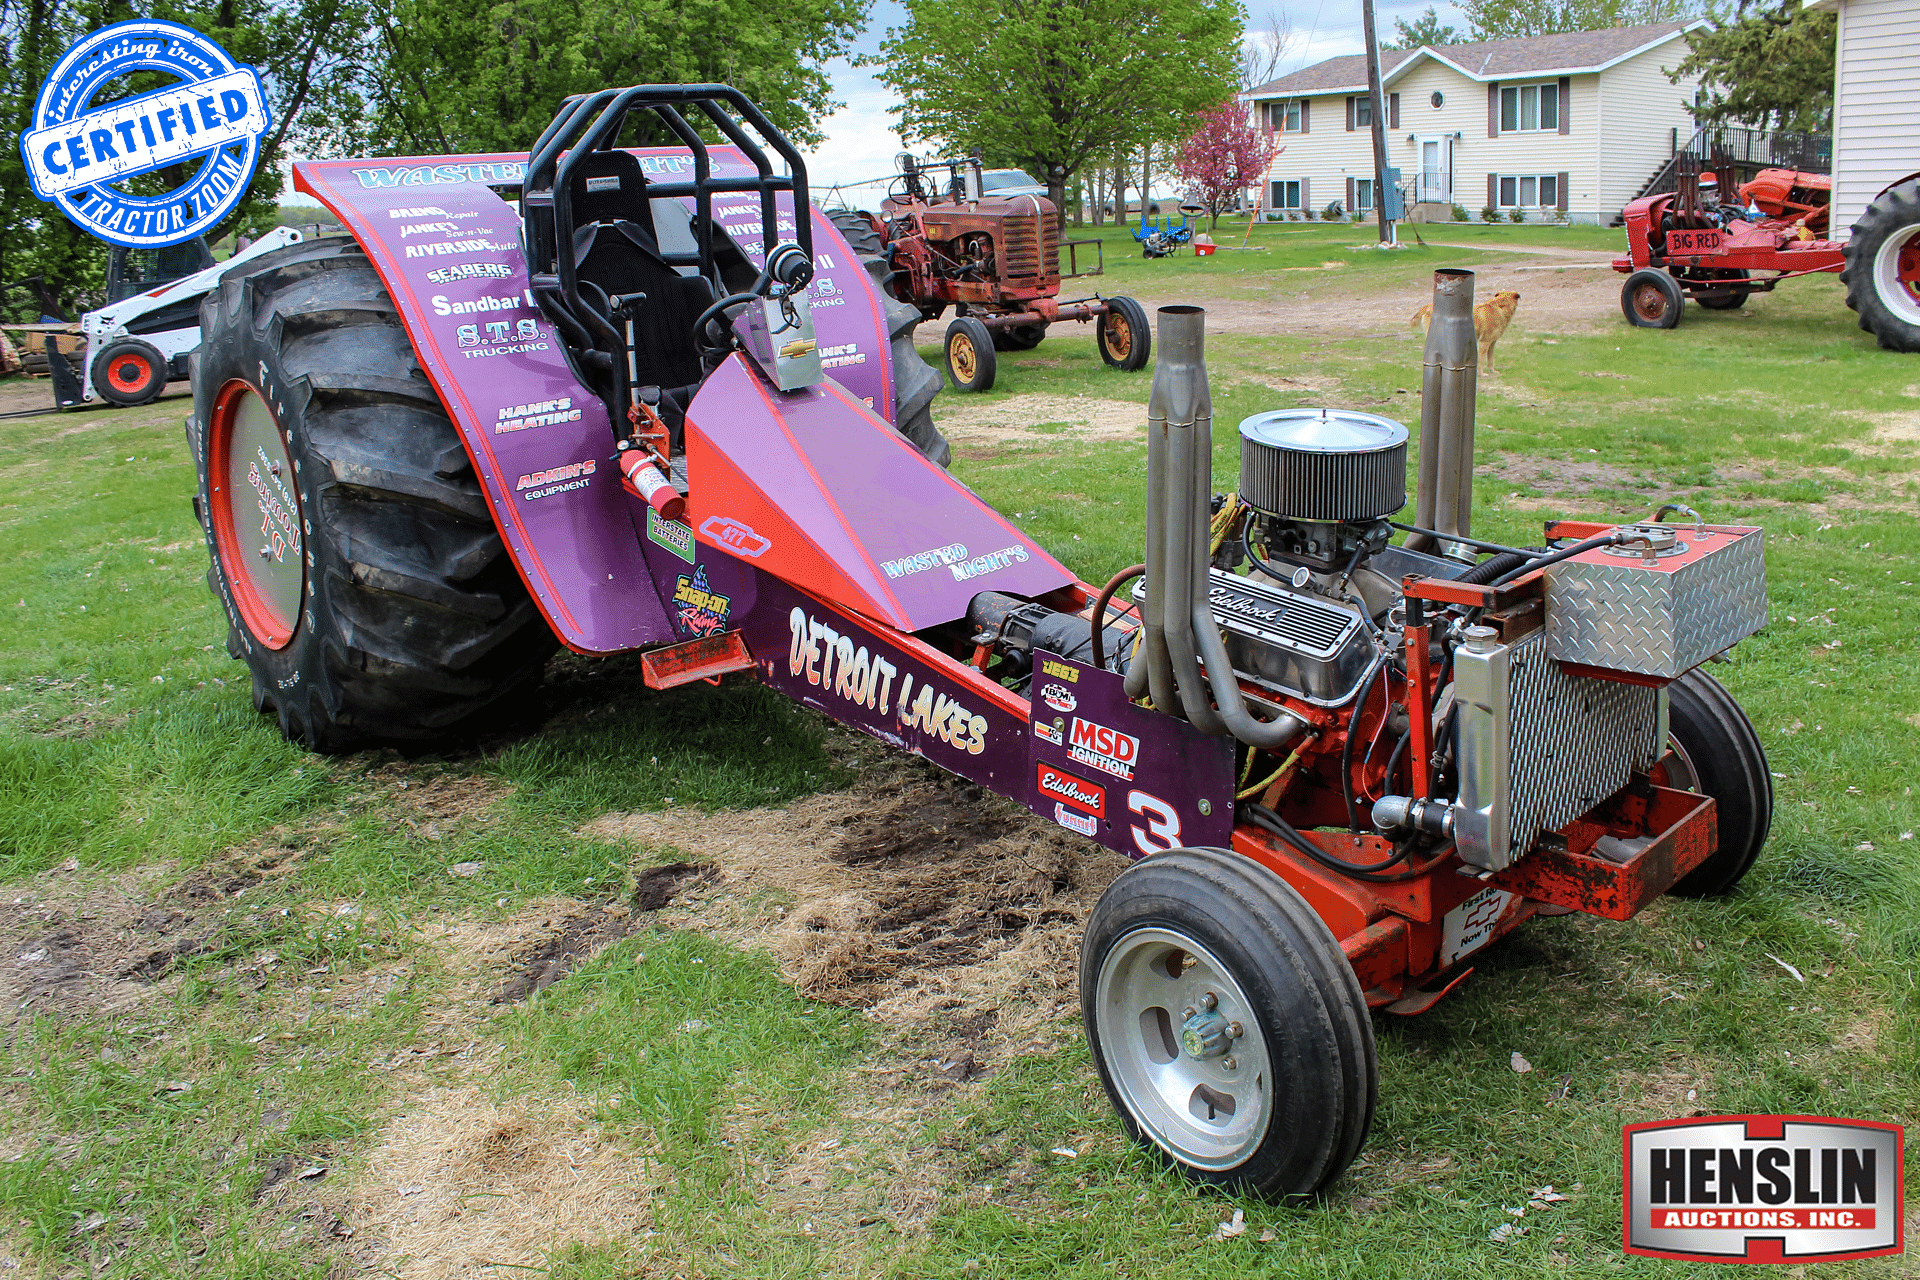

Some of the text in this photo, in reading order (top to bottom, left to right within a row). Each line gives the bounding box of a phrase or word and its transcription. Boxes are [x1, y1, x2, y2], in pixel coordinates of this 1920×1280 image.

[445, 211, 479, 220] Repair
[445, 227, 494, 238] Sew-n-Vac
[1673, 233, 1720, 250] BIG RED
[405, 238, 518, 258] RIVERSIDE Auto
[426, 262, 514, 284] SEABERG
[431, 295, 521, 316] Sandbar
[456, 318, 548, 348] S.T.S.
[461, 342, 549, 359] TRUCKING
[494, 409, 582, 434] HEATING
[498, 398, 572, 420] HANK'S
[516, 460, 596, 491] ADKIN'S
[525, 478, 590, 500] EQUIPMENT
[247, 462, 301, 555] Towing
[651, 512, 691, 542] INTERSTATE
[653, 525, 689, 551] BATTERIES
[722, 526, 747, 547] 477
[880, 543, 969, 580] WASTED
[948, 544, 1030, 582] NIGHT'S
[675, 578, 728, 615] Snap-on
[1209, 587, 1281, 622] Edelbrock
[788, 606, 989, 756] DETROIT LAKES
[1072, 718, 1135, 762] MSD
[1070, 744, 1131, 779] IGNITION
[1041, 772, 1101, 809] Edelbrock
[1127, 789, 1184, 856] 3
[1461, 891, 1485, 912] First
[1461, 930, 1483, 948] Now
